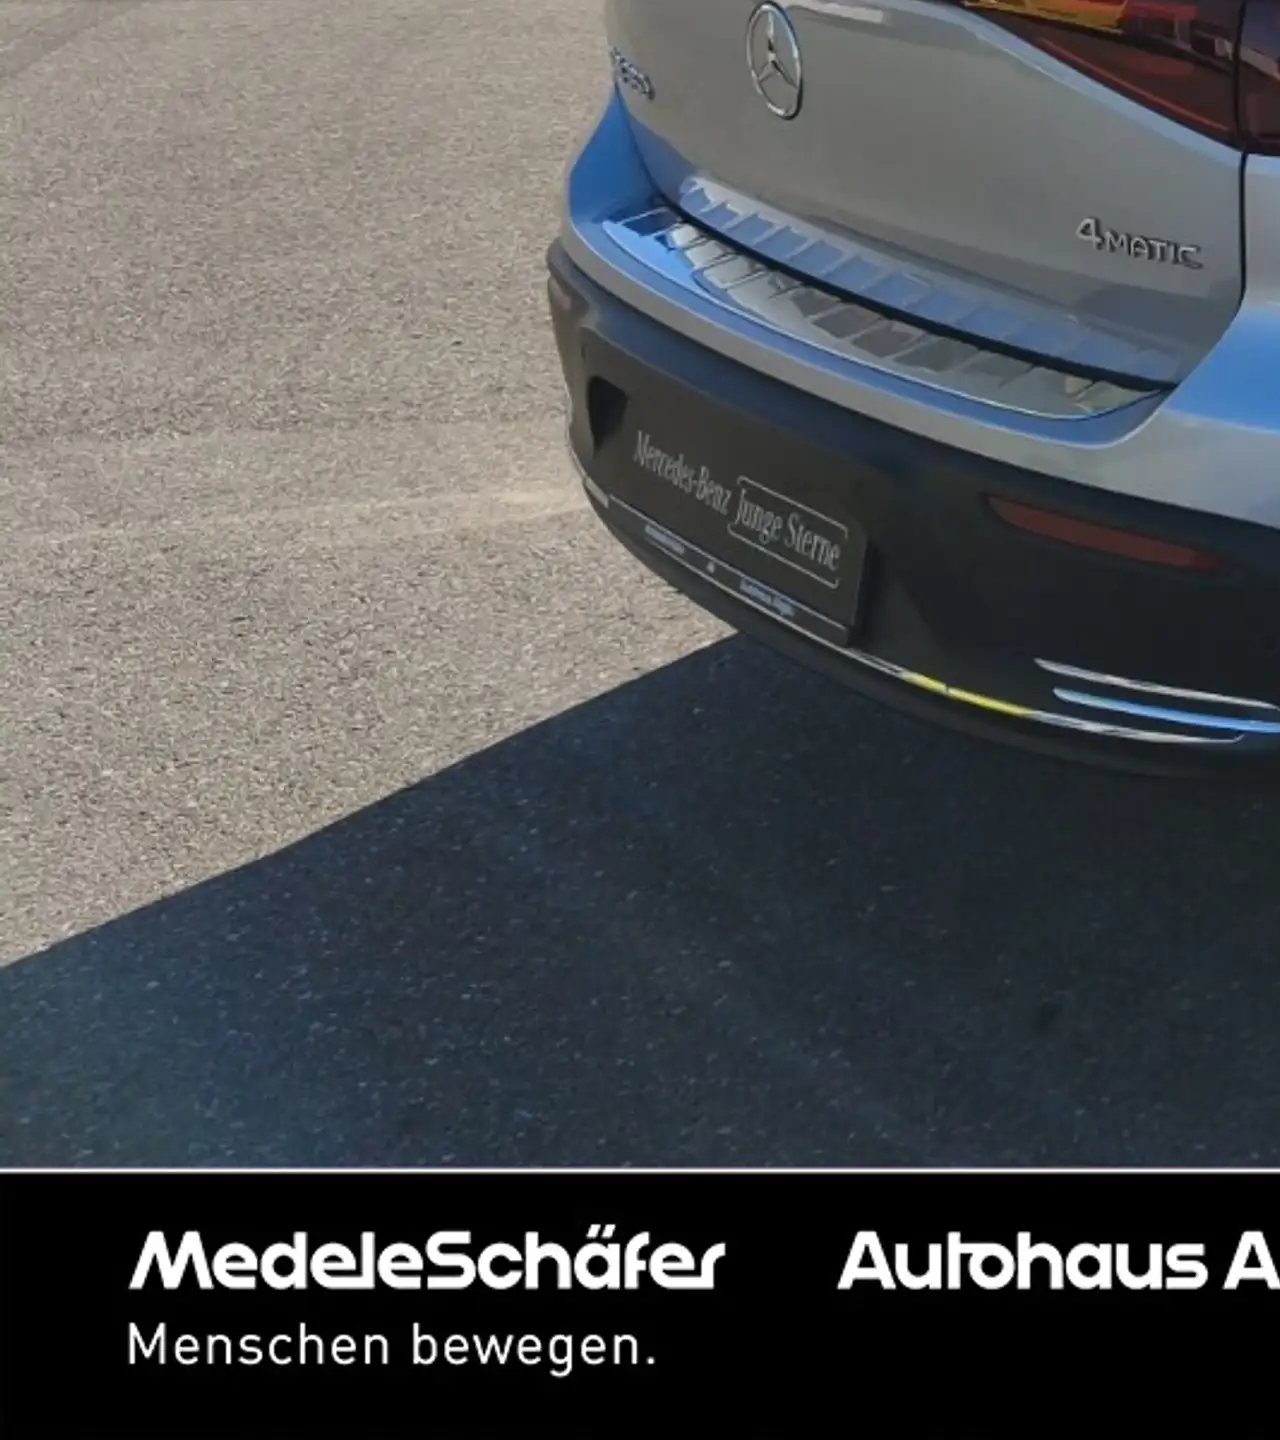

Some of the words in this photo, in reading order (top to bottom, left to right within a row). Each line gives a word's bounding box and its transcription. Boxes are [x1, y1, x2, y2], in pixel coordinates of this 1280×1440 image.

[1076, 217, 1204, 269] 4MATIC
[633, 430, 733, 515] Mercedes-Benz
[734, 487, 782, 545] Junge
[784, 512, 842, 571] Sterne
